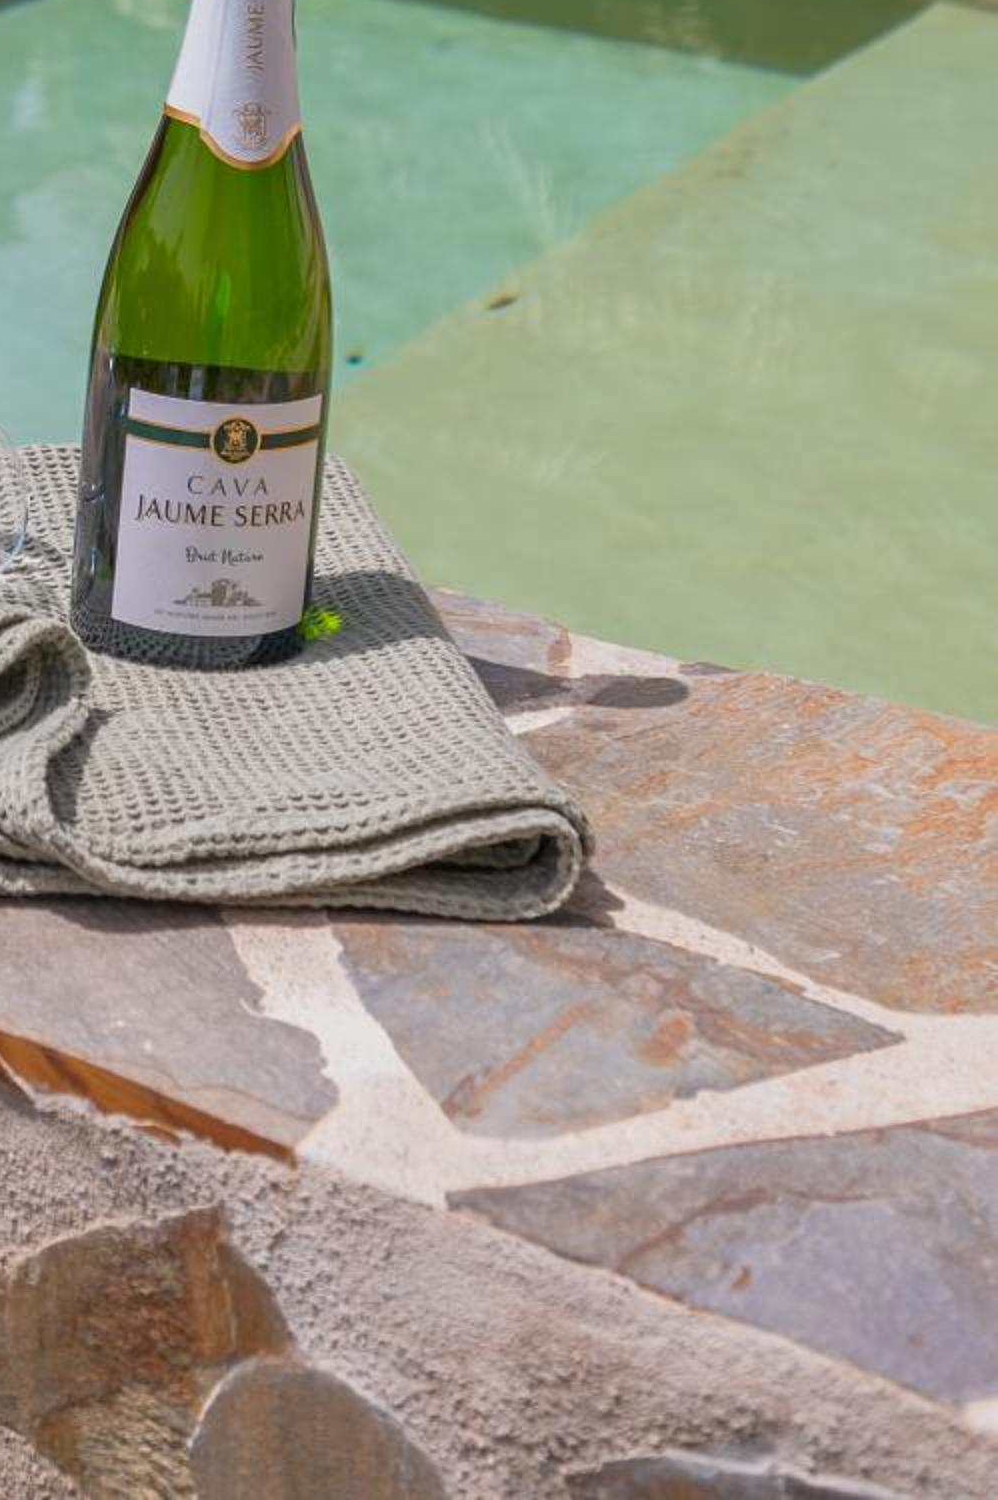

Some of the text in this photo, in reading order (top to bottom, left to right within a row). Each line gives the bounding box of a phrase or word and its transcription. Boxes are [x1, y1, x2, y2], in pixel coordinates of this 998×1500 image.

[245, 3, 266, 72] JAUME
[186, 475, 269, 497] CAVA
[135, 494, 306, 528] JAUME SERRA
[185, 546, 218, 564] Brut
